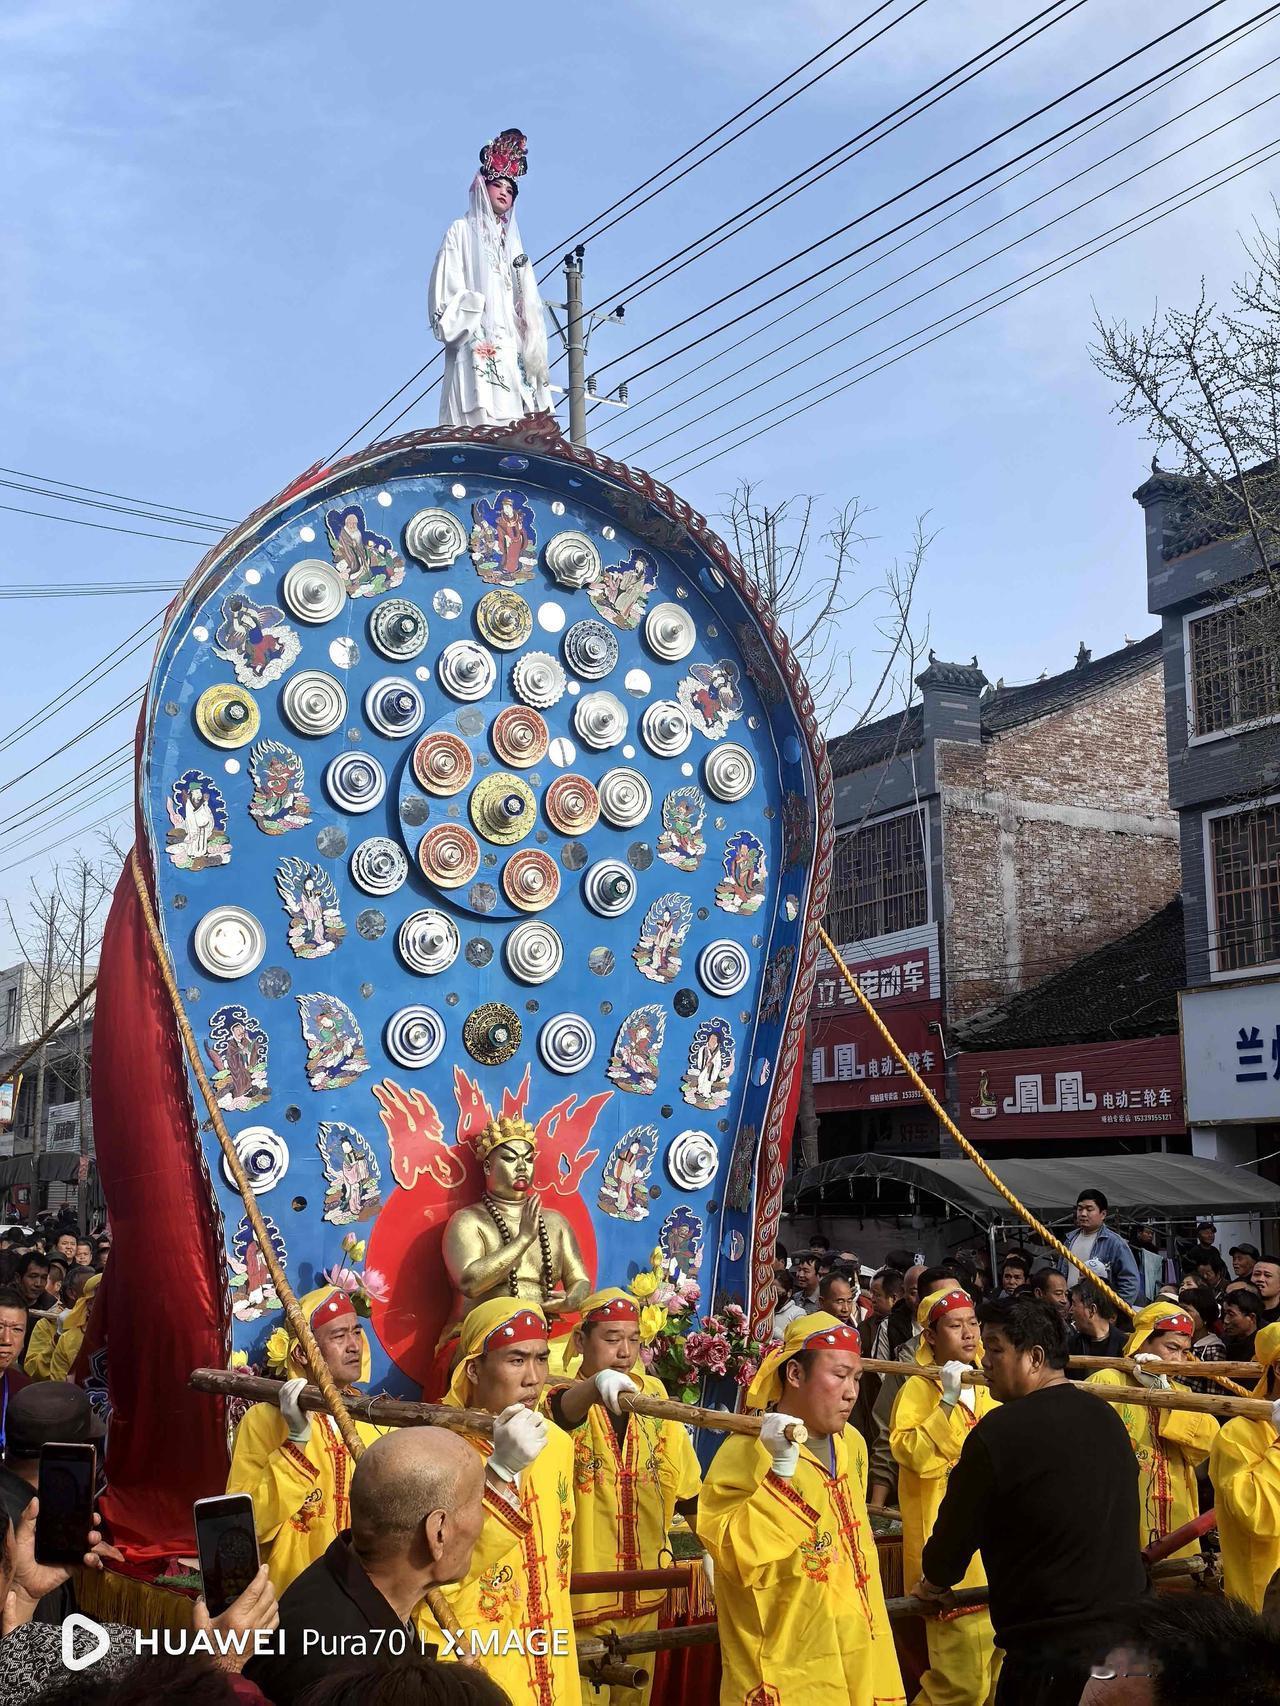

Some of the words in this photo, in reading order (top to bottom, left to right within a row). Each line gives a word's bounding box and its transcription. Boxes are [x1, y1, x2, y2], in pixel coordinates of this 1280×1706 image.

[1103, 1088, 1172, 1109] 电动三轮车
